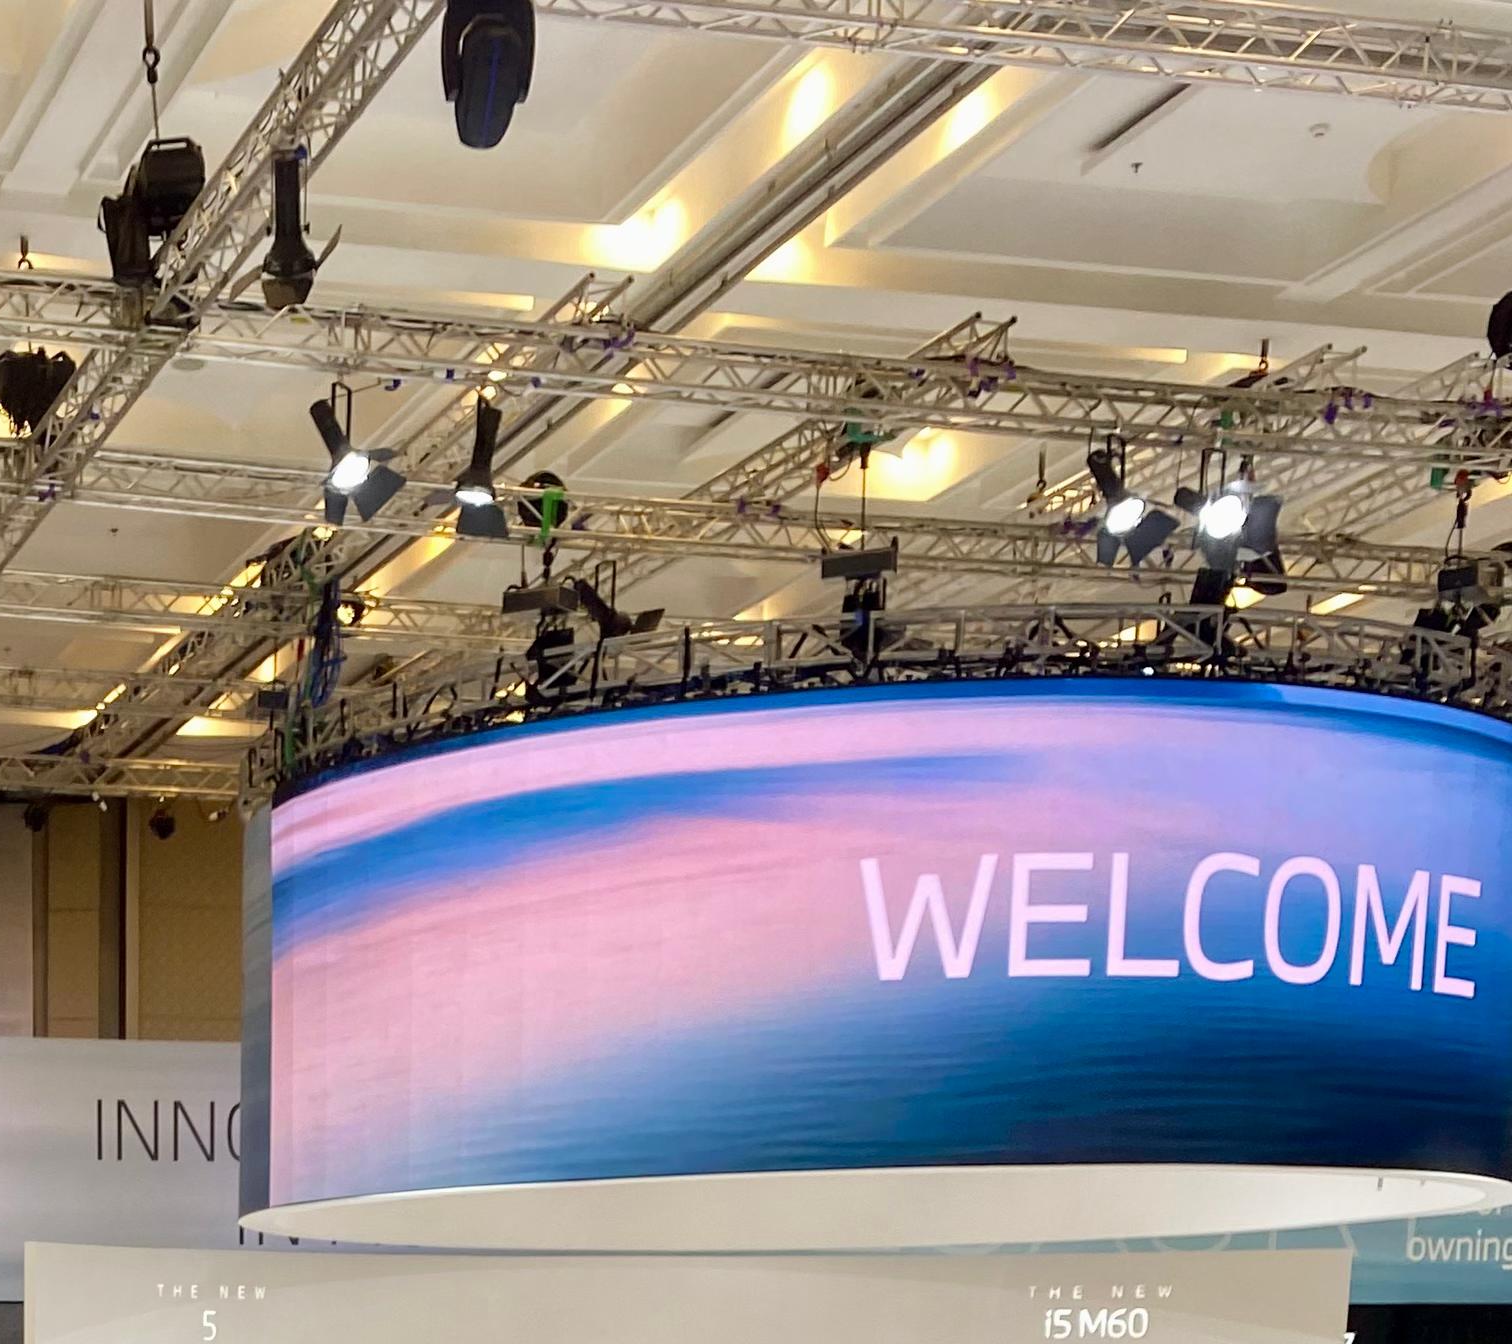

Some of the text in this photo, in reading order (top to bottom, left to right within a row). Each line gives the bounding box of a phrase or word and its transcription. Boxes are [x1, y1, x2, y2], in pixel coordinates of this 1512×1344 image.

[859, 851, 1482, 999] WELCOME
[156, 1283, 266, 1300] THE NEW
[1029, 1284, 1173, 1300] THE NEW
[202, 1309, 217, 1341] 5
[1044, 1307, 1149, 1340] i5 M60
